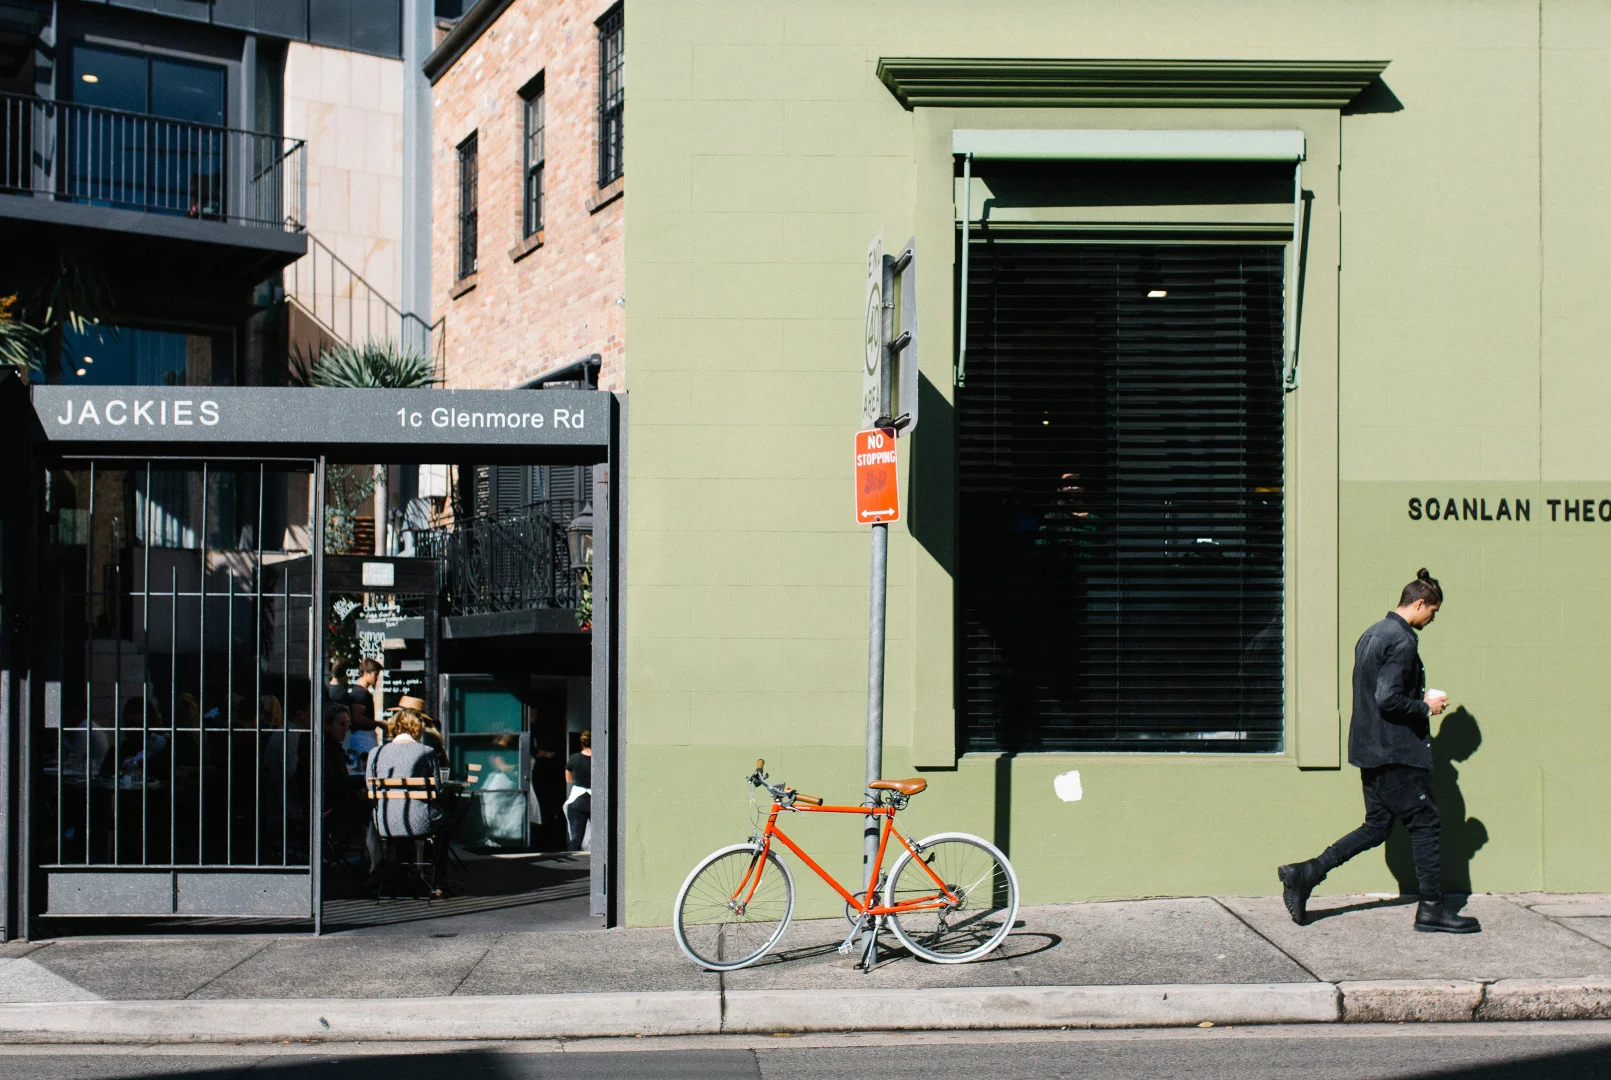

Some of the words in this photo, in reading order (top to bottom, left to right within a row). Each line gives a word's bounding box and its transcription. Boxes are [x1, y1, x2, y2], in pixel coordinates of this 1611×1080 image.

[867, 303, 880, 353] 40
[57, 399, 220, 426] JACKIES
[863, 383, 880, 420] AREA
[397, 407, 423, 428] 1c
[431, 407, 545, 428] Glenmore
[553, 408, 585, 429] Rd
[867, 433, 884, 450] NO
[857, 450, 896, 467] STOPPING
[1408, 497, 1530, 521] SCANLAN
